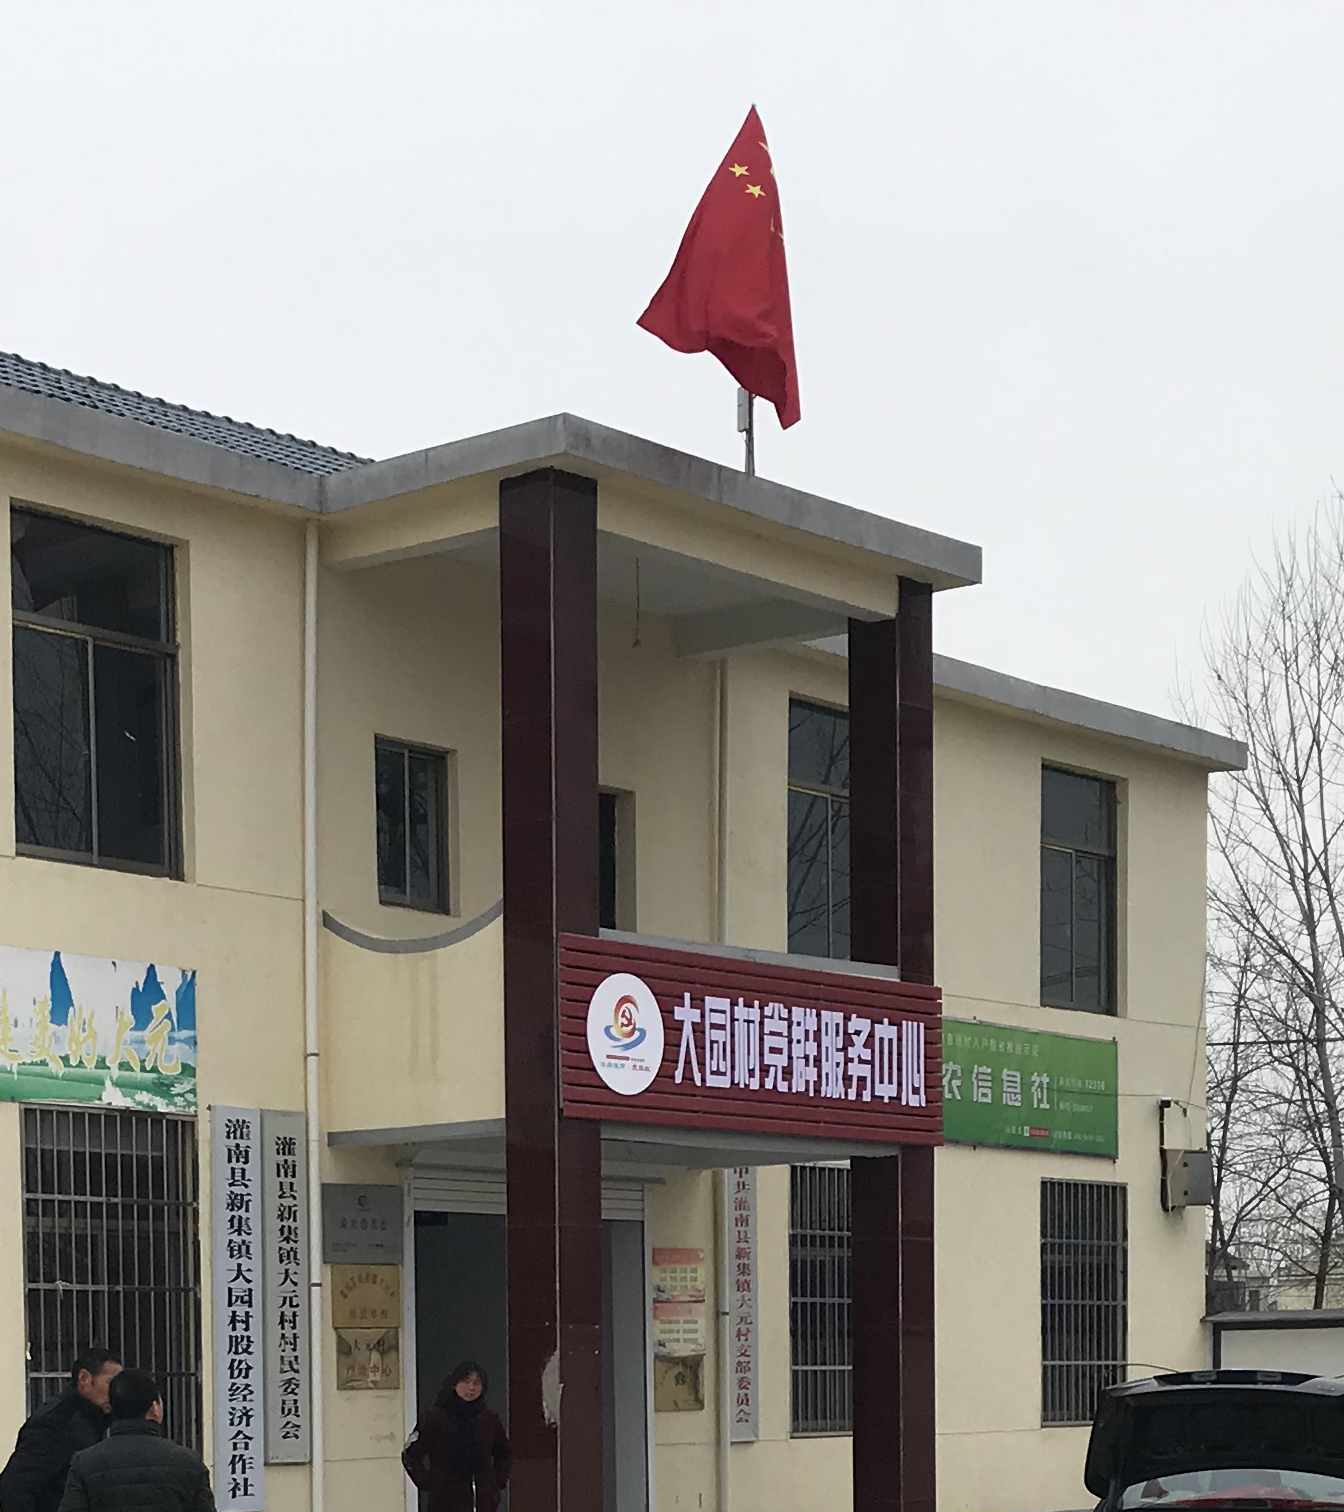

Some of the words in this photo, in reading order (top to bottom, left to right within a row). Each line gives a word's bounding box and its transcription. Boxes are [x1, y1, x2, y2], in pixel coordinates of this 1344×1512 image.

[674, 991, 926, 1107] 大园村党群服务中心
[224, 1117, 255, 1499] 灌南县新集镇大园村股份经济合作社
[275, 1136, 302, 1440] 灌南县新集镇大元村村民委员会
